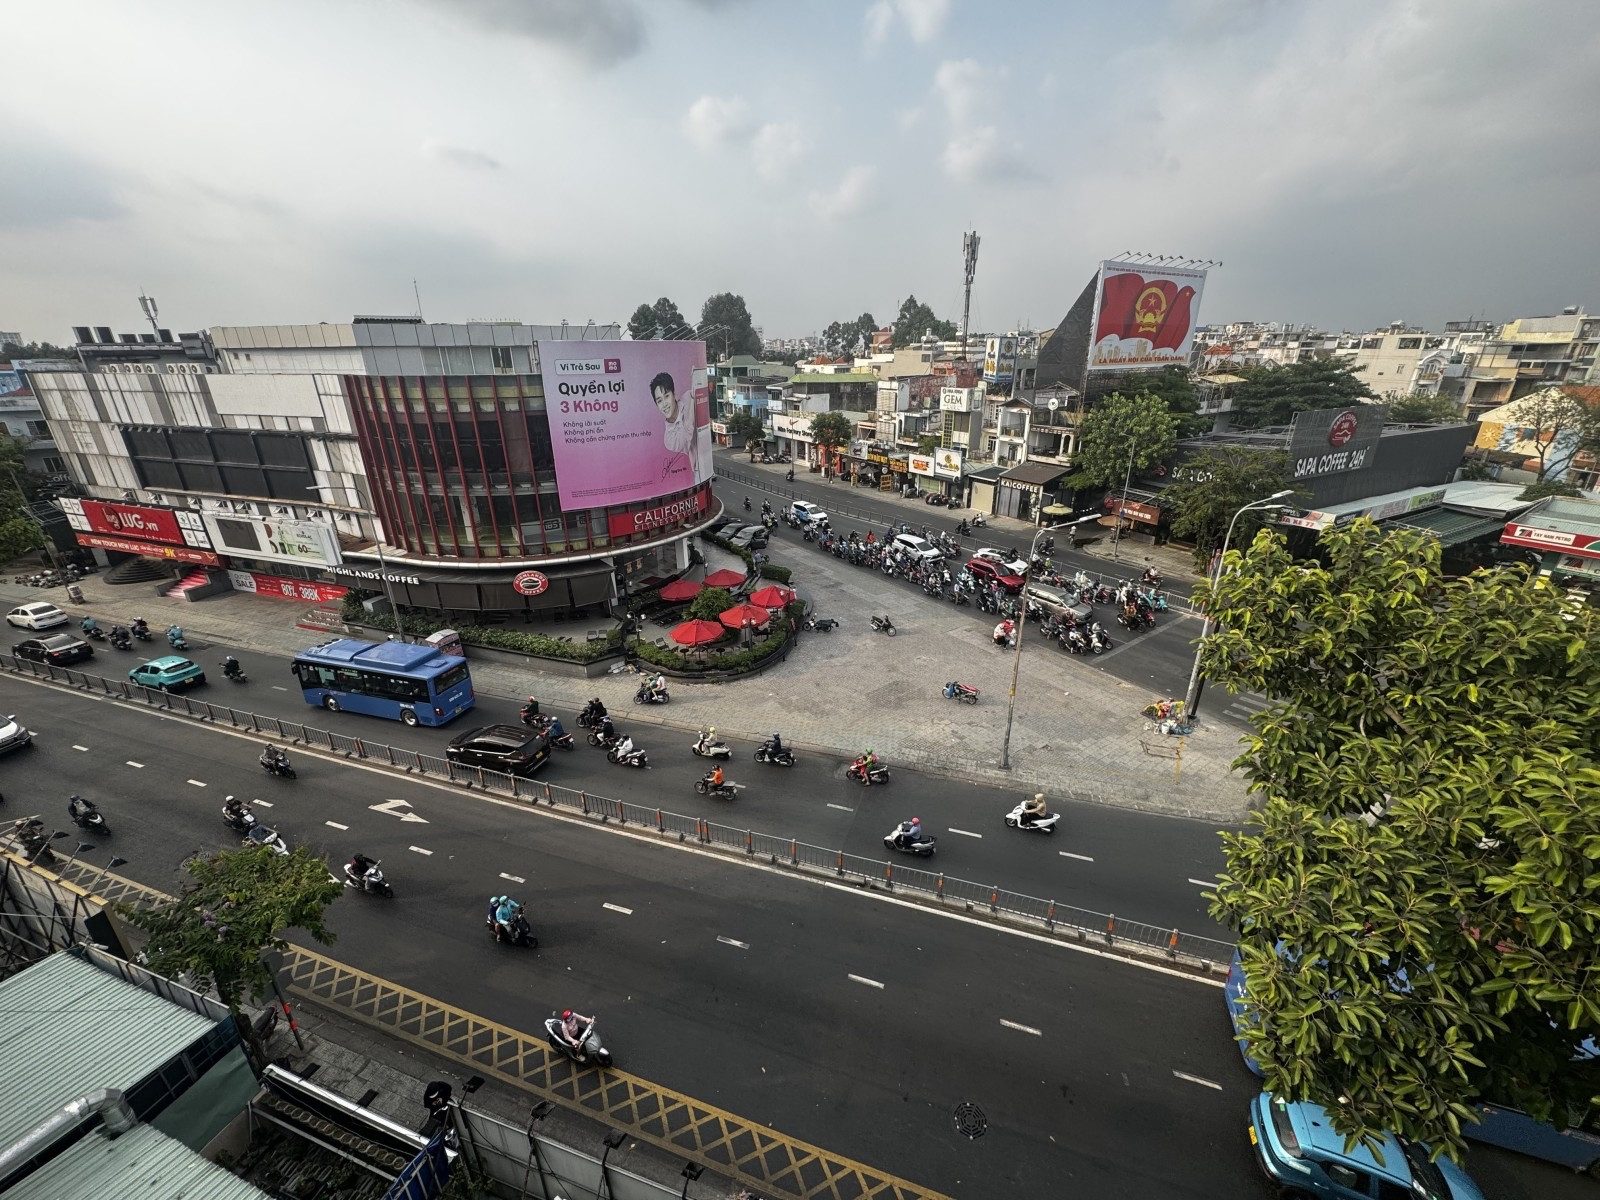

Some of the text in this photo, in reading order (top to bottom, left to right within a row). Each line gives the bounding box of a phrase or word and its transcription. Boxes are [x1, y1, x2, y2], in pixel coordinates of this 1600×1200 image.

[558, 380, 625, 396] Quyền lợi
[560, 399, 619, 413] 3 Không
[944, 394, 962, 405] GEM
[565, 436, 585, 444] Không
[1294, 449, 1366, 478] SAPA COFFEE 24H
[1013, 483, 1038, 493] COFFEE
[634, 496, 699, 524] CALIFORNIA
[634, 515, 674, 532] FITNESS
[326, 566, 380, 580] HIGHLANDS
[236, 579, 255, 589] SALE
